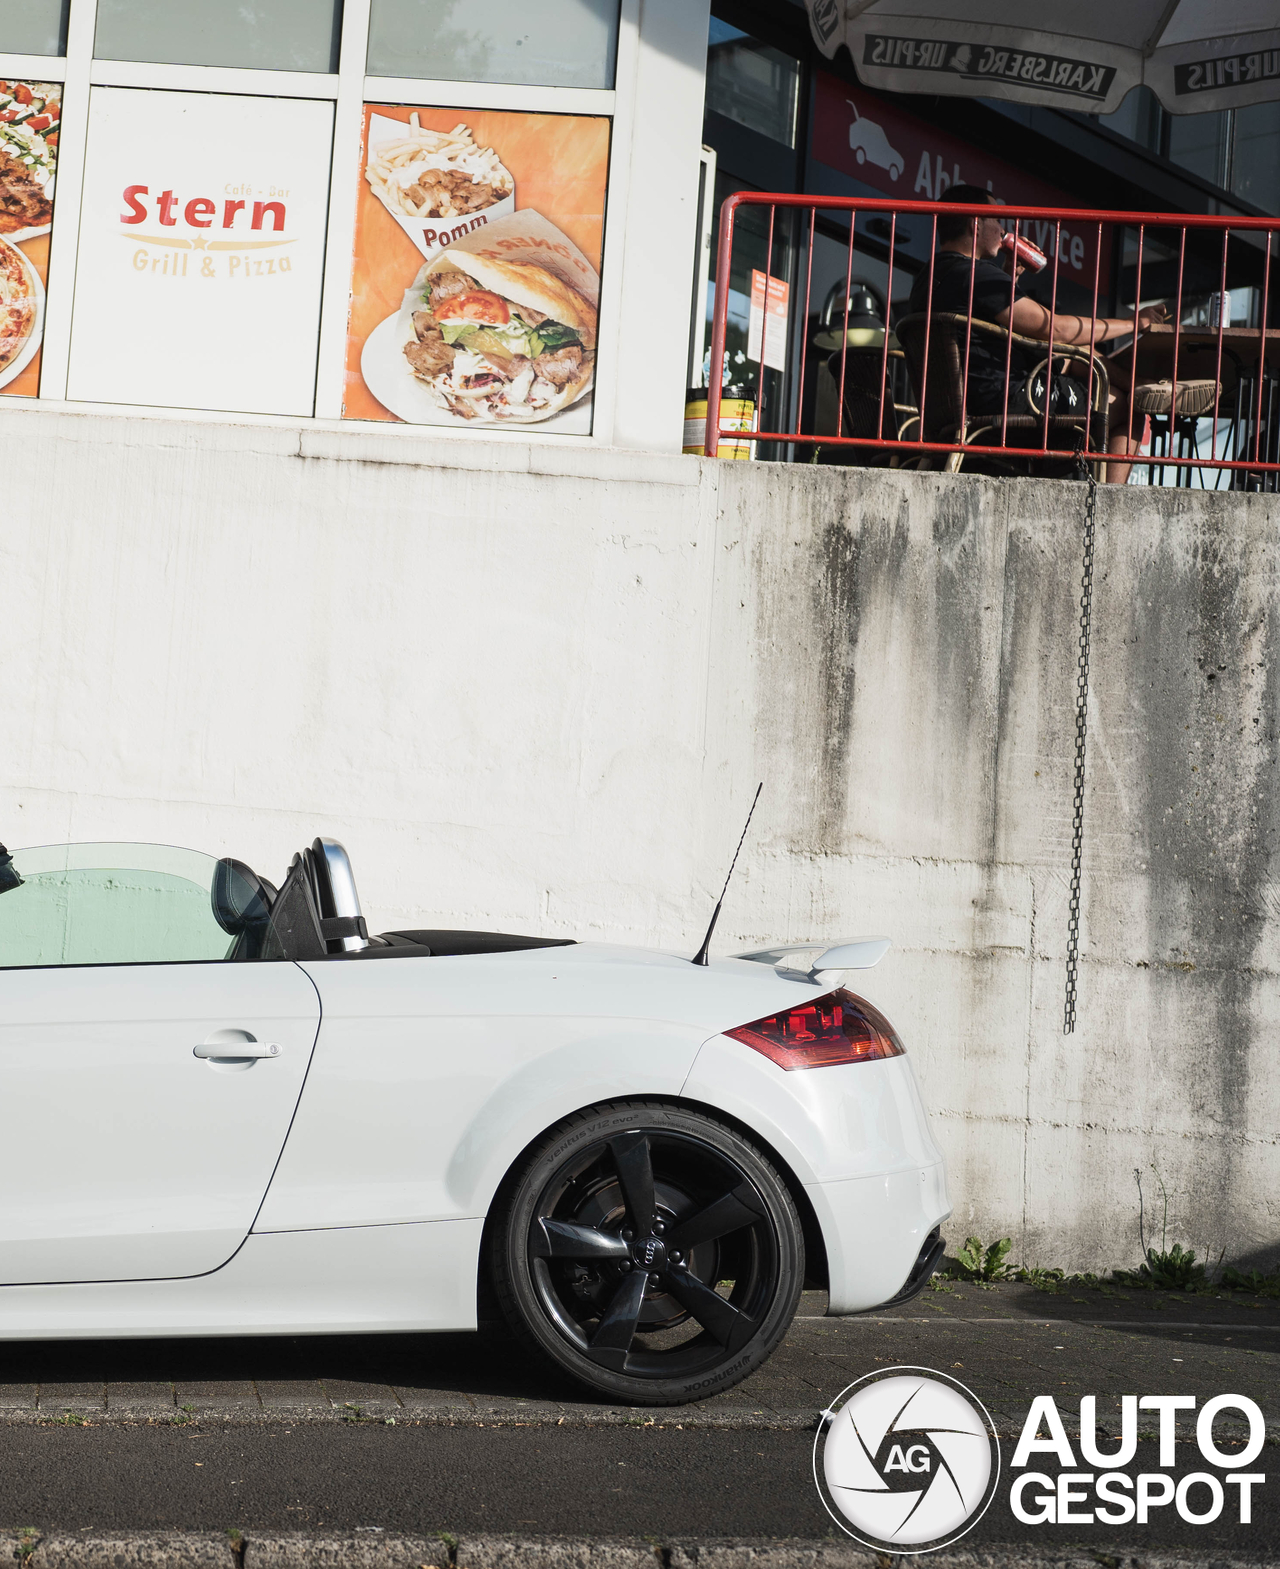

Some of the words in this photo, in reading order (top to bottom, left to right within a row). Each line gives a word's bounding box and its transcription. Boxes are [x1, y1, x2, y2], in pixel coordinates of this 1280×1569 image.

[224, 183, 252, 195] Café
[120, 184, 286, 231] Stern
[132, 248, 188, 277] Grill
[200, 256, 216, 278] &
[229, 255, 292, 277] Pizza
